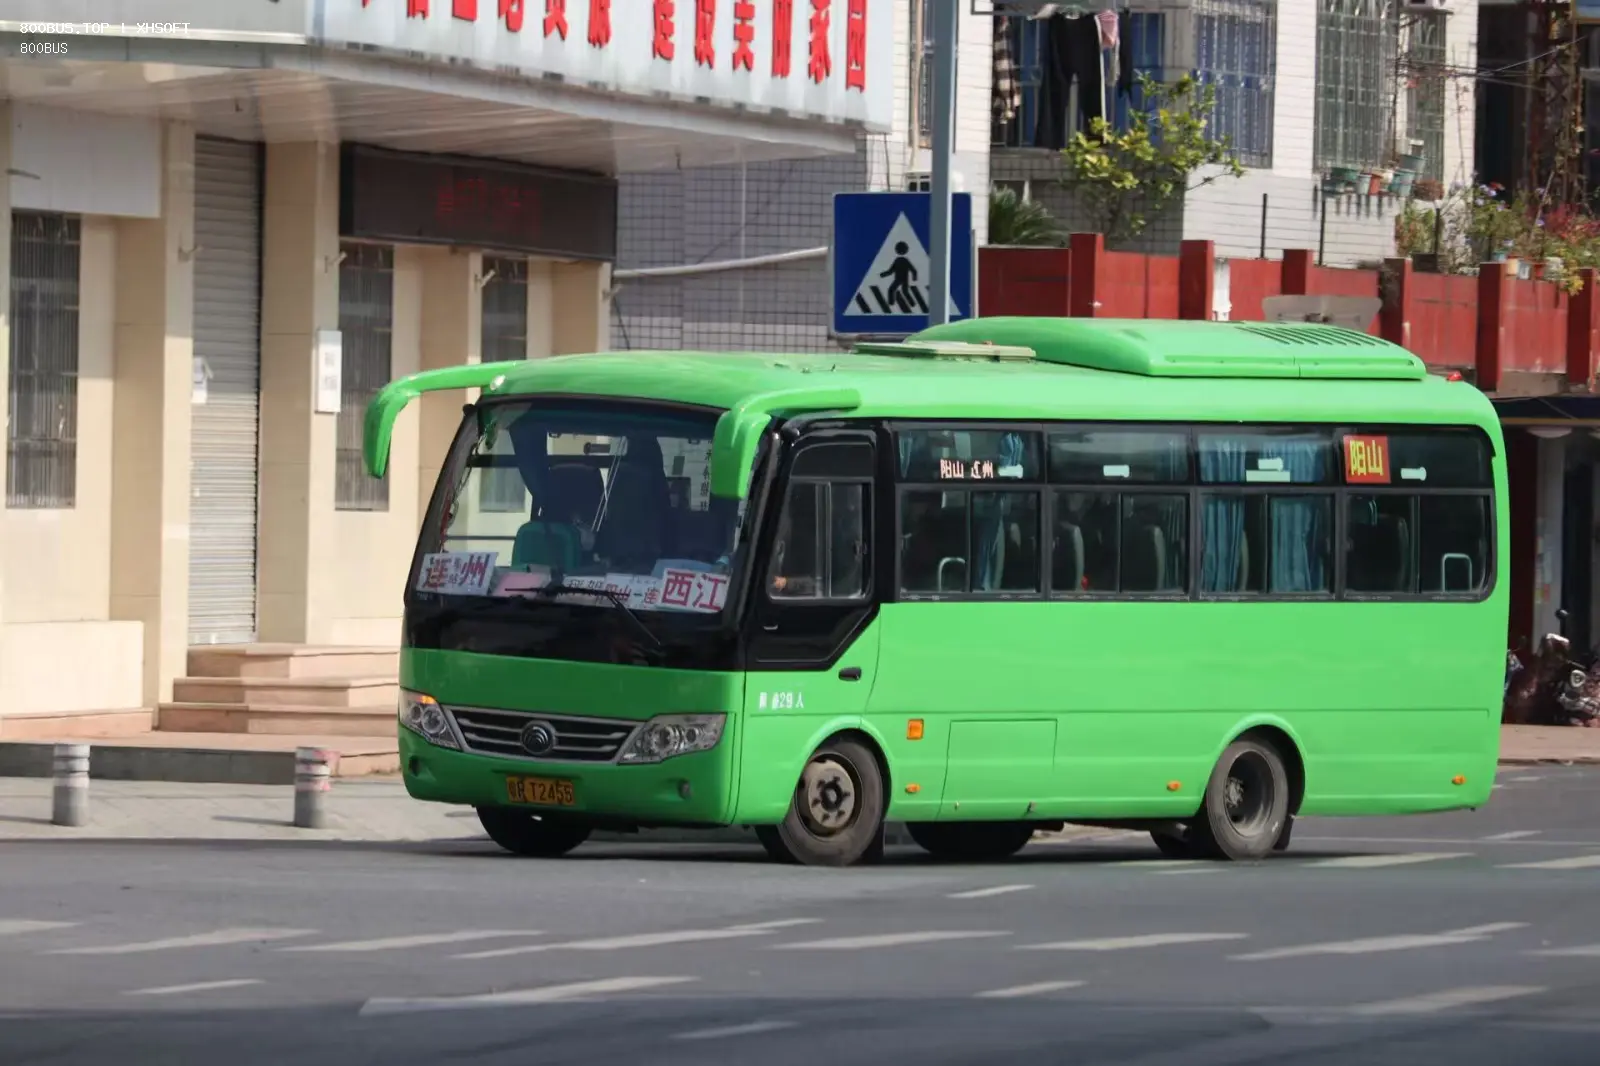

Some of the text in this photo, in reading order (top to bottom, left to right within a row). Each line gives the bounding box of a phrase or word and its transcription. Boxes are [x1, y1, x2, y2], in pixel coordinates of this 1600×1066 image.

[940, 459, 964, 478] 阳山
[1349, 439, 1384, 476] 阳山
[661, 568, 727, 611] 西江
